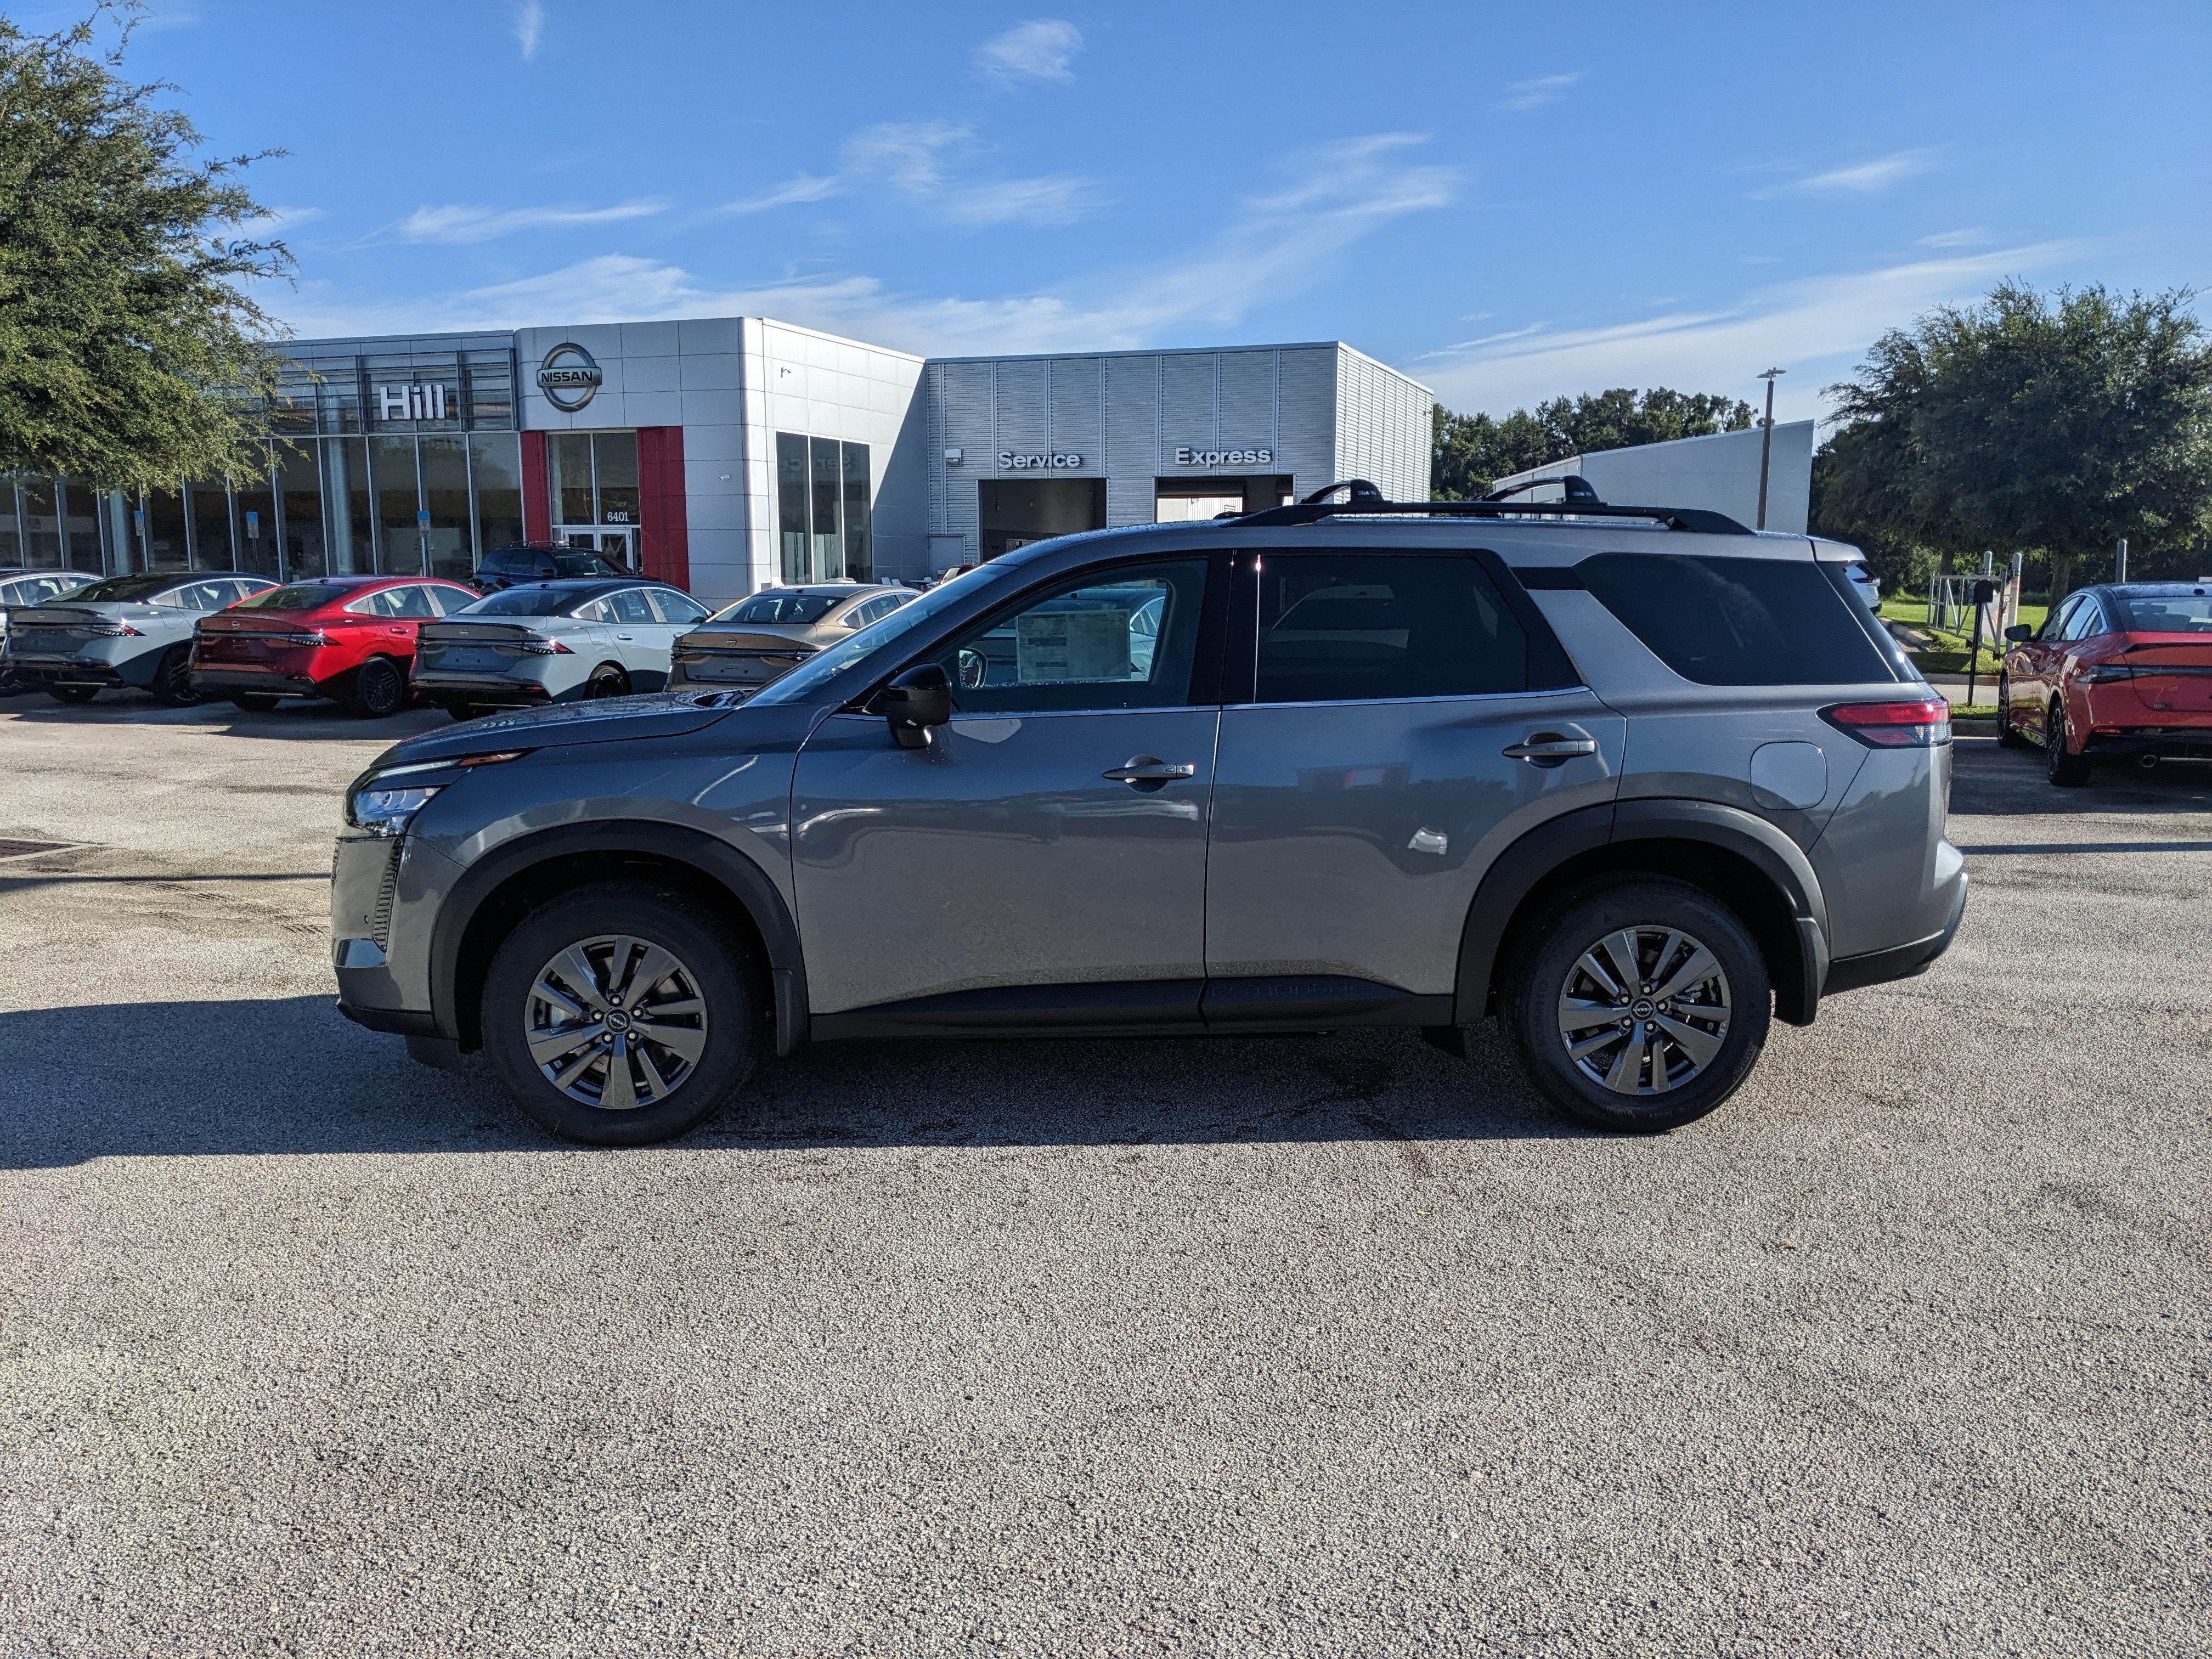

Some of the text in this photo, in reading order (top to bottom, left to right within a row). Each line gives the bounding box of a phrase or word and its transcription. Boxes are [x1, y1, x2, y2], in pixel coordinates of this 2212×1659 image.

[541, 370, 593, 382] NISSAN
[380, 385, 444, 420] Hill
[998, 452, 1080, 469] Service
[1175, 447, 1271, 468] Express
[607, 511, 629, 523] 6401
